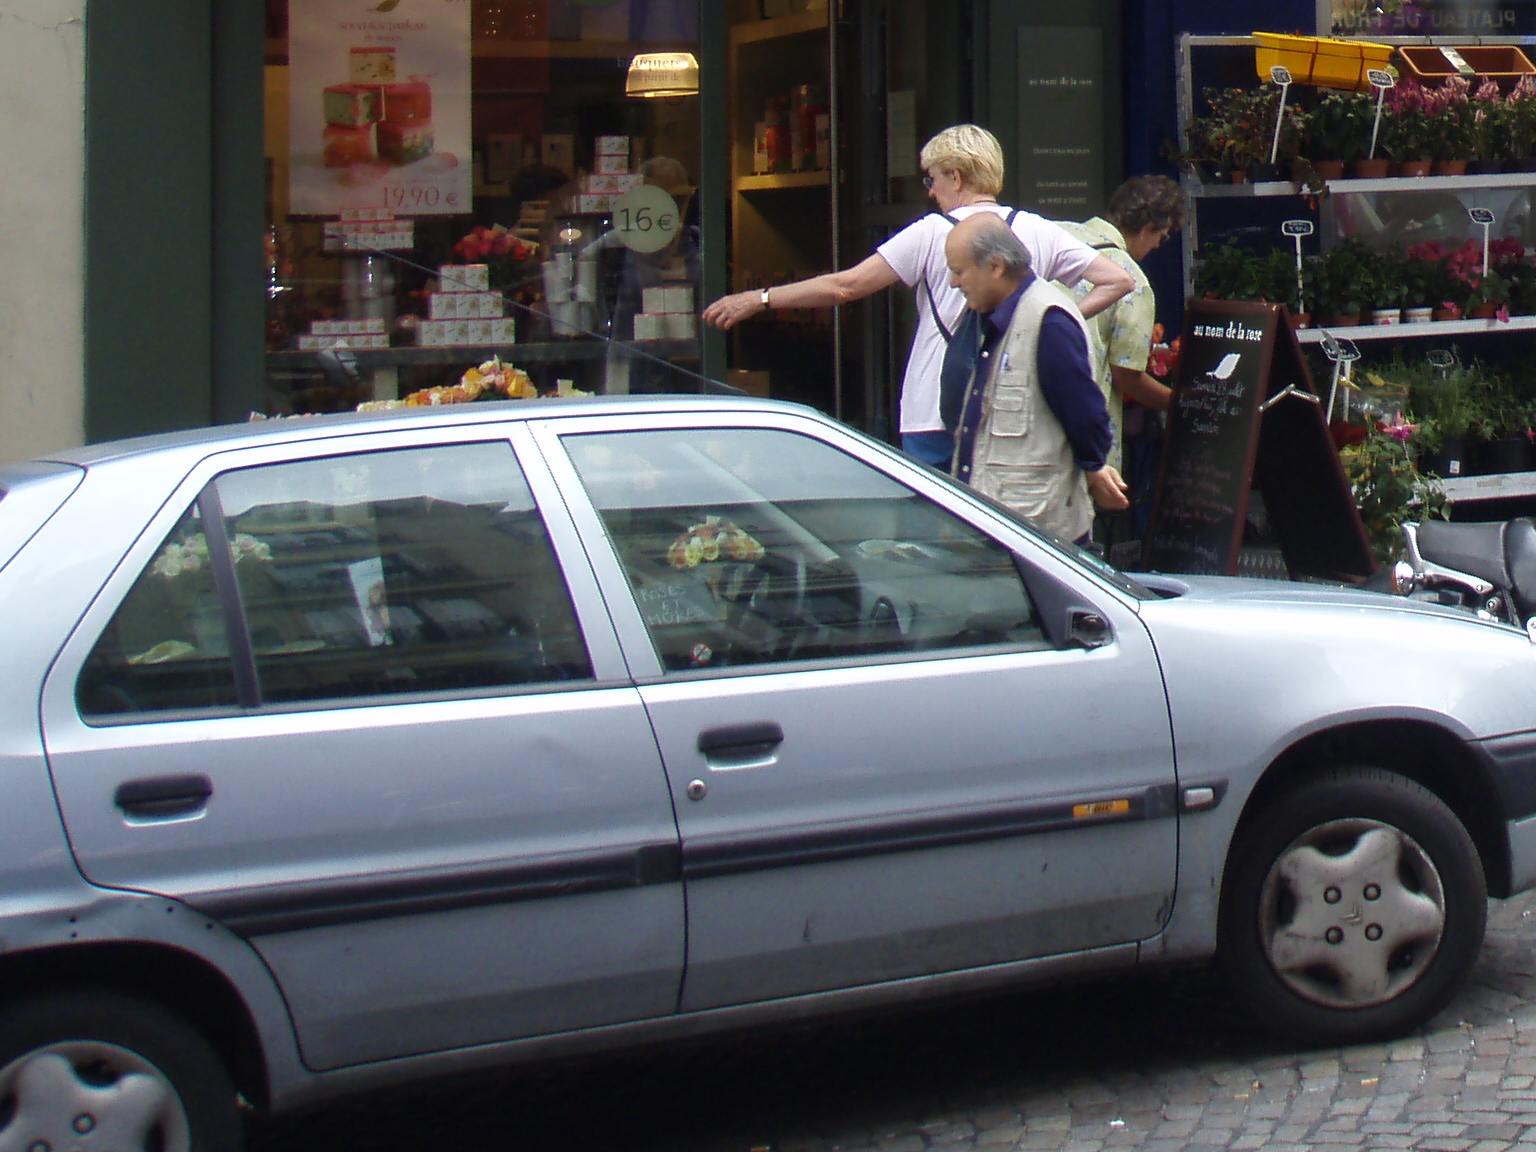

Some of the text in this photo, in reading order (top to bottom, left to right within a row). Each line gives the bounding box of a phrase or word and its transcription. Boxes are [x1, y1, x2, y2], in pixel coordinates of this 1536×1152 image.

[384, 186, 440, 209] 19,90
[1193, 321, 1263, 341] au nom de la rose
